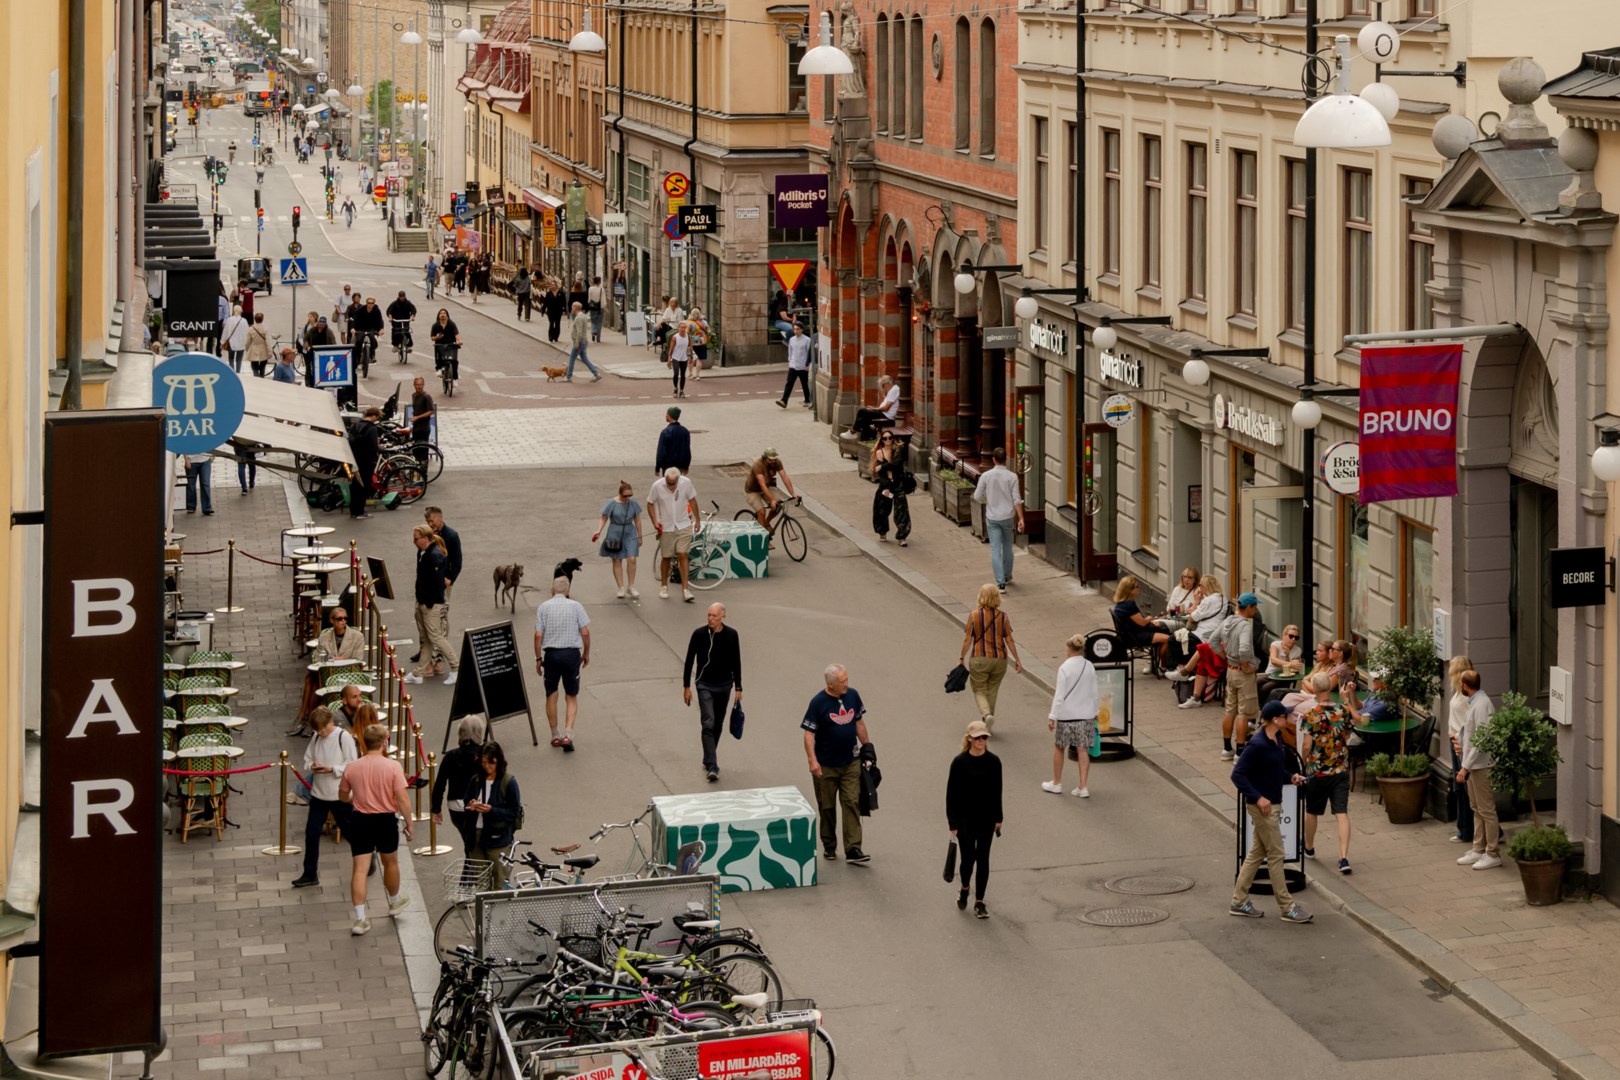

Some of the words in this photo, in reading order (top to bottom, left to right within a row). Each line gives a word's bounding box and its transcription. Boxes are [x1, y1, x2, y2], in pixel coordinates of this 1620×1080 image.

[778, 190, 818, 201] Adlibris
[170, 321, 215, 331] GRANIT
[1363, 408, 1452, 435] BRUNO
[1333, 457, 1359, 468] Brö
[1563, 571, 1595, 585] BECORE
[1551, 688, 1563, 702] BRUNO
[66, 577, 140, 839] BAR
[709, 1060, 725, 1073] EN
[727, 1052, 801, 1071] MILJARDÄRS-
